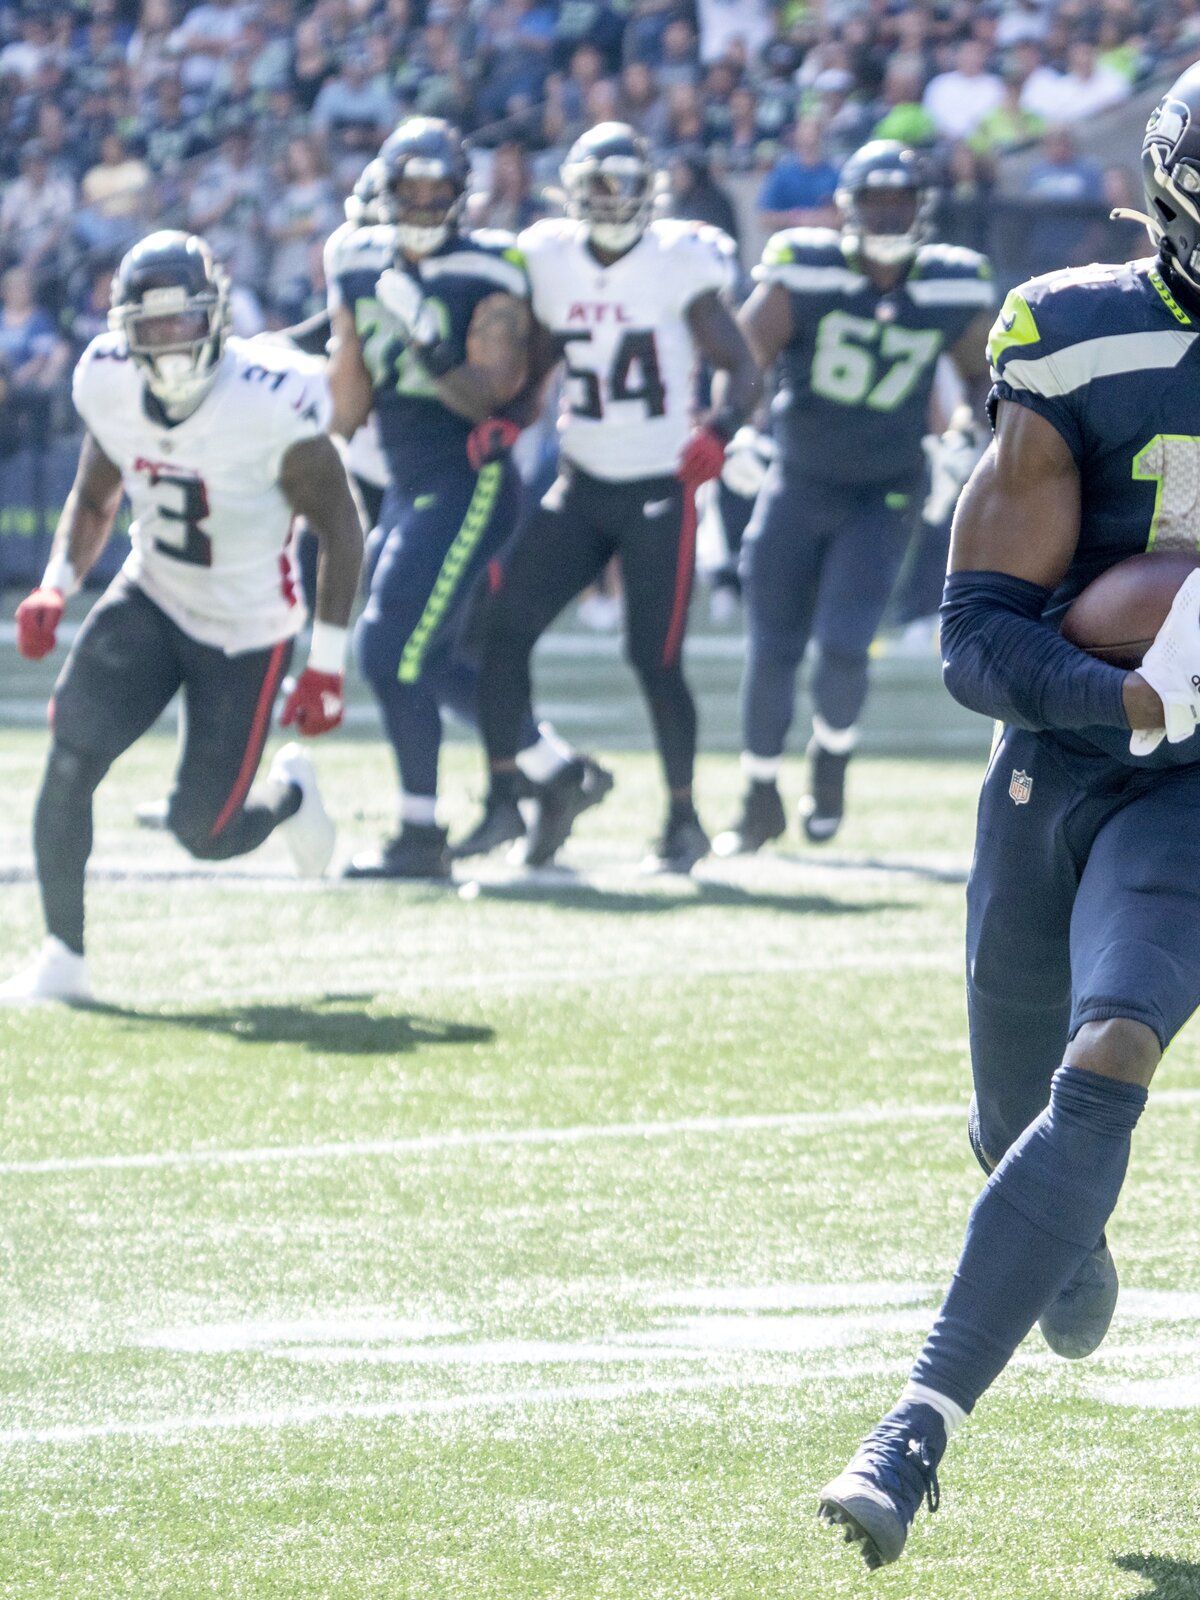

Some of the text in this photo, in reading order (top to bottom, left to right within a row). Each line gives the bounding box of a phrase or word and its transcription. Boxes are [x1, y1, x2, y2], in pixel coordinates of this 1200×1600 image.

[566, 303, 632, 324] ATL
[557, 328, 666, 419] 54
[810, 309, 943, 414] 67
[150, 472, 212, 568] 3
